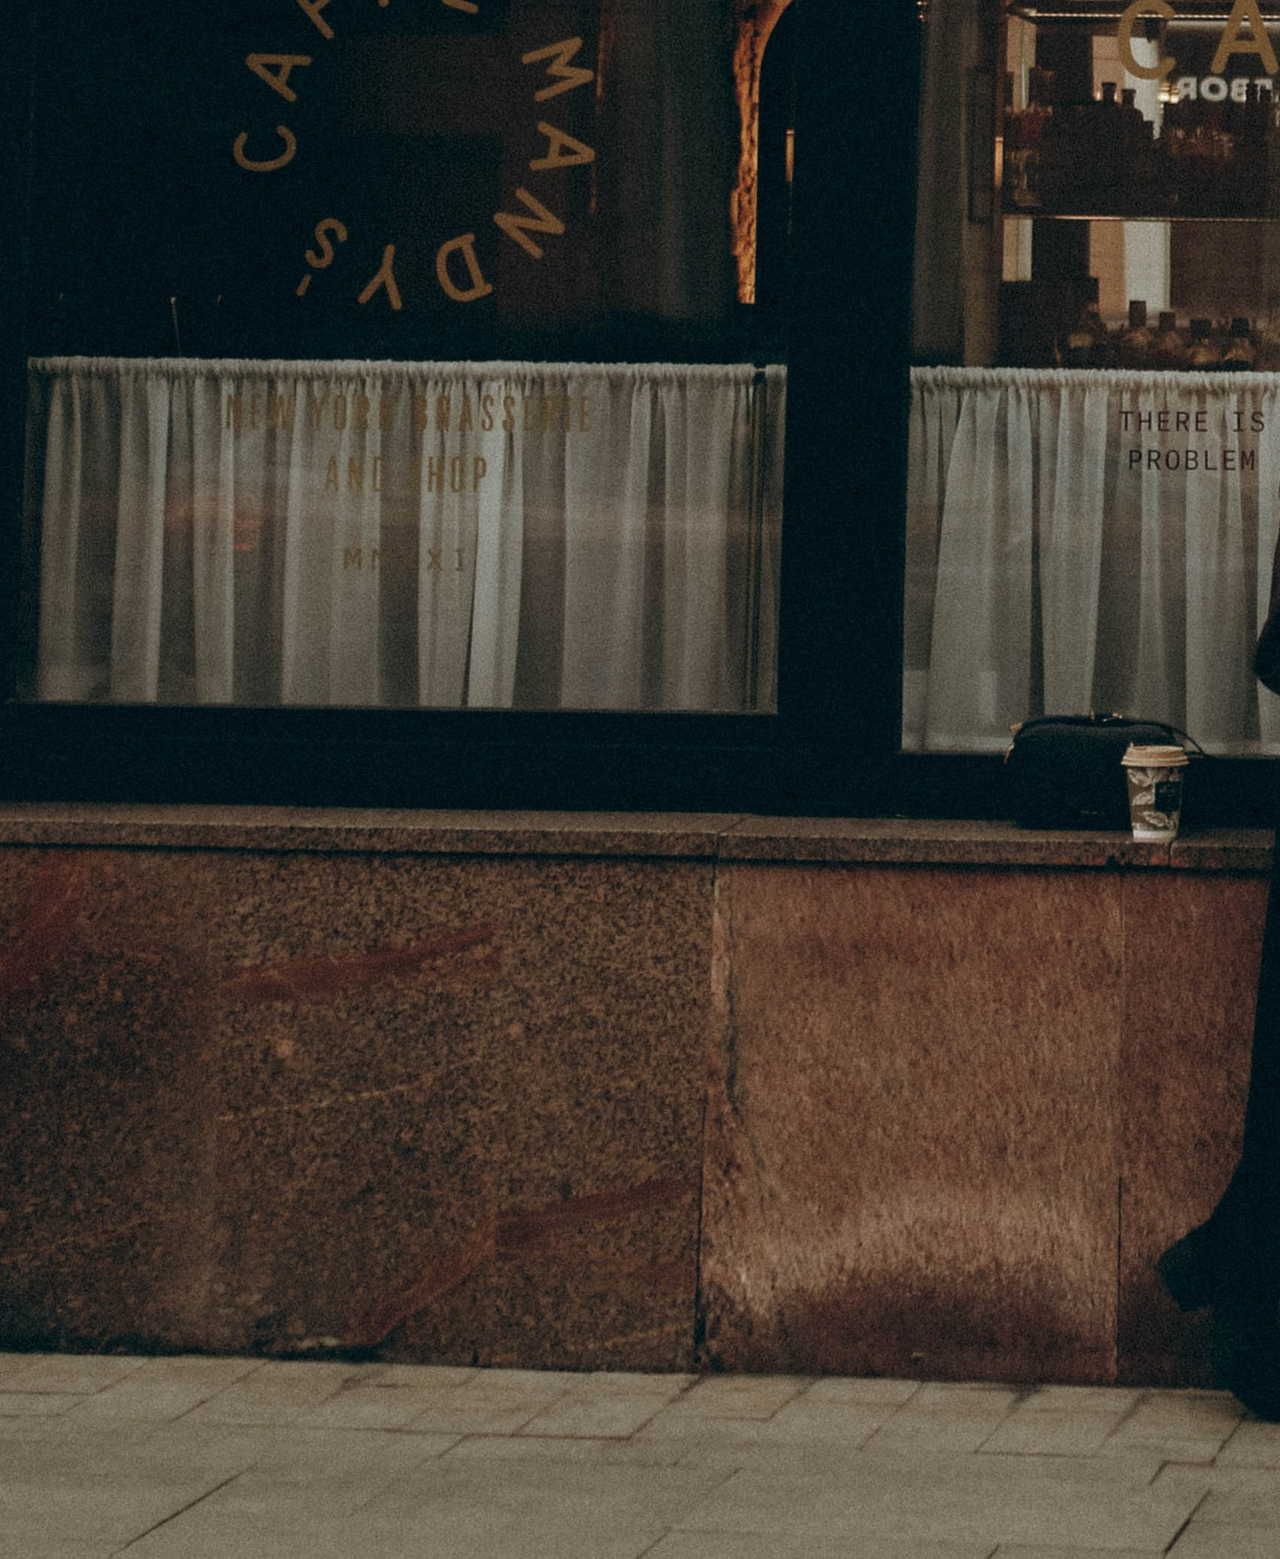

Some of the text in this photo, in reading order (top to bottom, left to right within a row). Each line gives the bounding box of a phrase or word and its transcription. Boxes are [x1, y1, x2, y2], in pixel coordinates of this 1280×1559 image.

[225, 393, 294, 430] NEW
[412, 393, 590, 433] BRASSERIE
[1119, 410, 1209, 433] THERE
[1232, 411, 1265, 433] IS
[1128, 449, 1257, 472] PROBLEM
